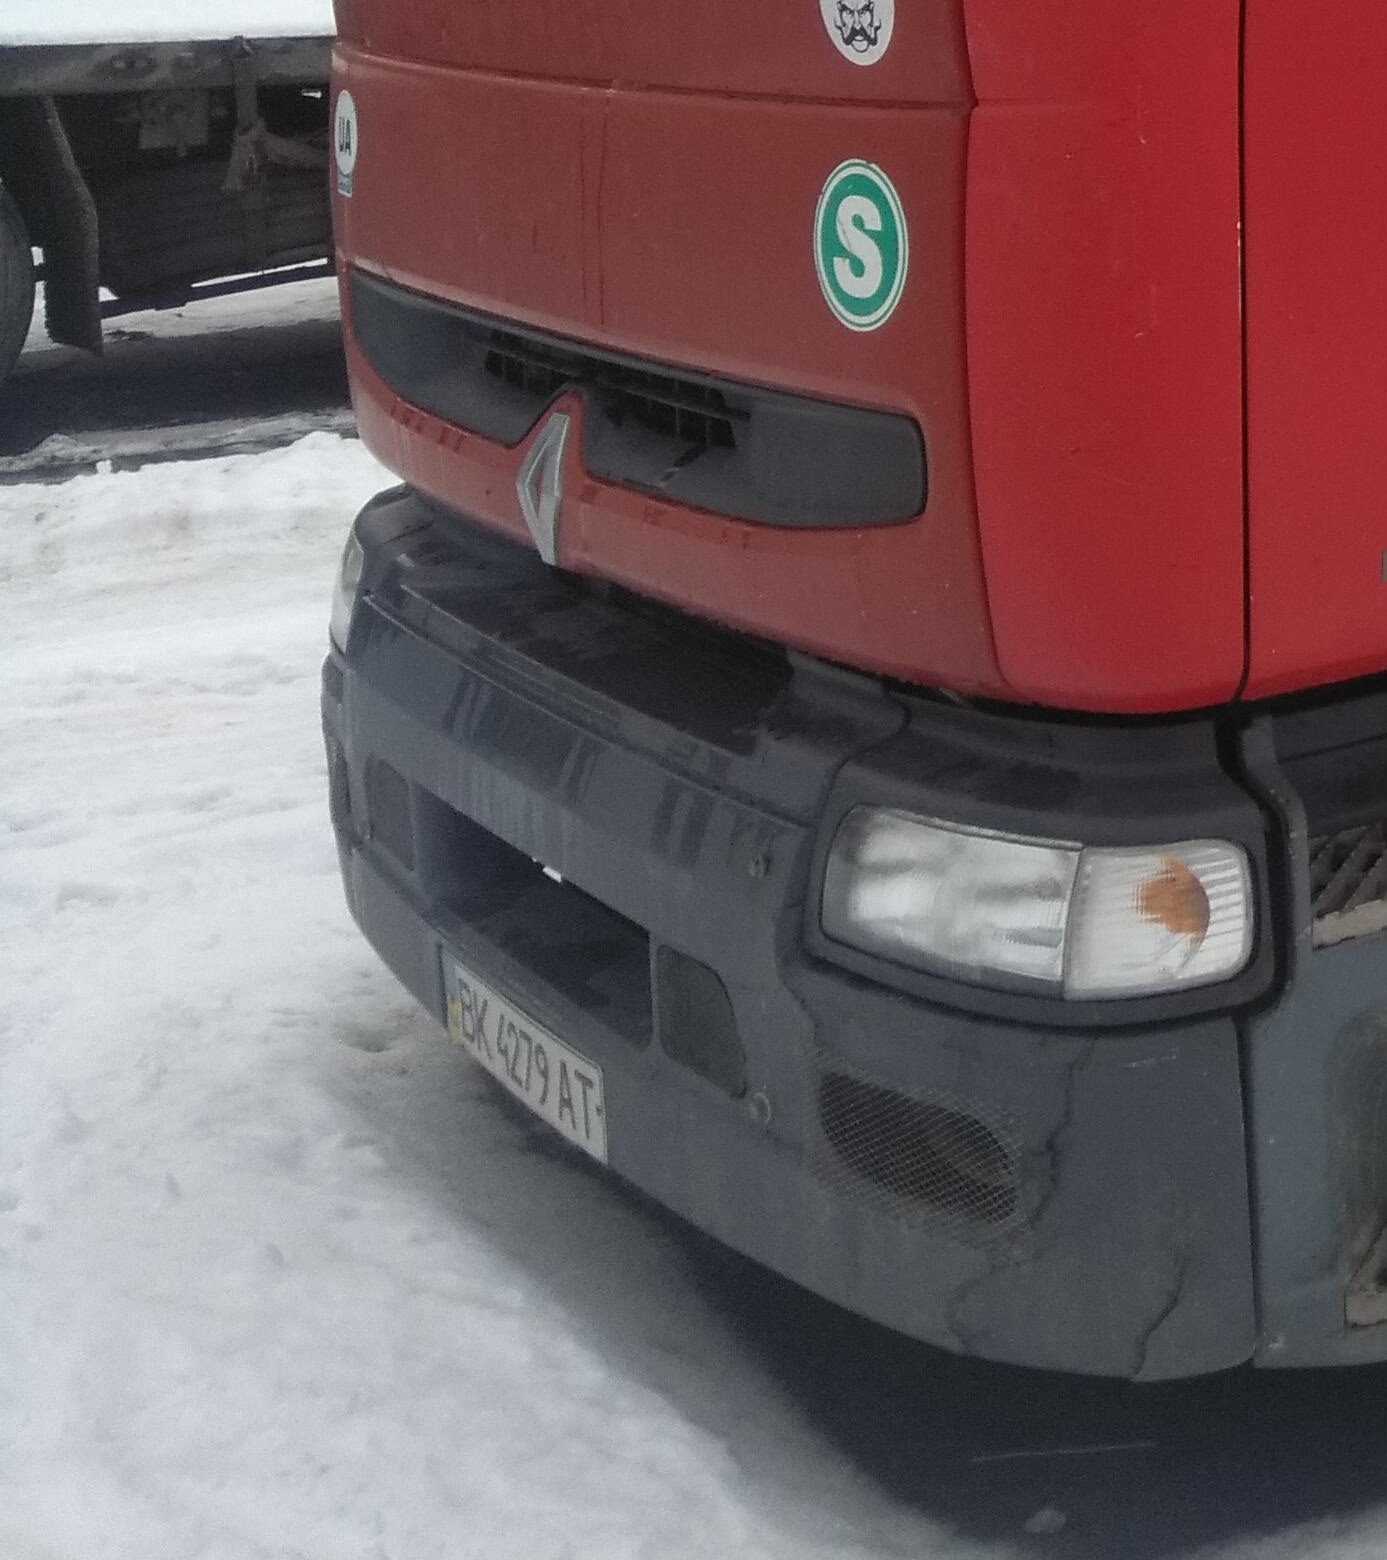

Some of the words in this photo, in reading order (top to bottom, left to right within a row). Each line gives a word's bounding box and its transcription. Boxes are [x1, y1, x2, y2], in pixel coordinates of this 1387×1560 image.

[338, 116, 352, 157] UA
[832, 195, 883, 299] S
[496, 1014, 549, 1106] 4279
[558, 1060, 594, 1140] AT
